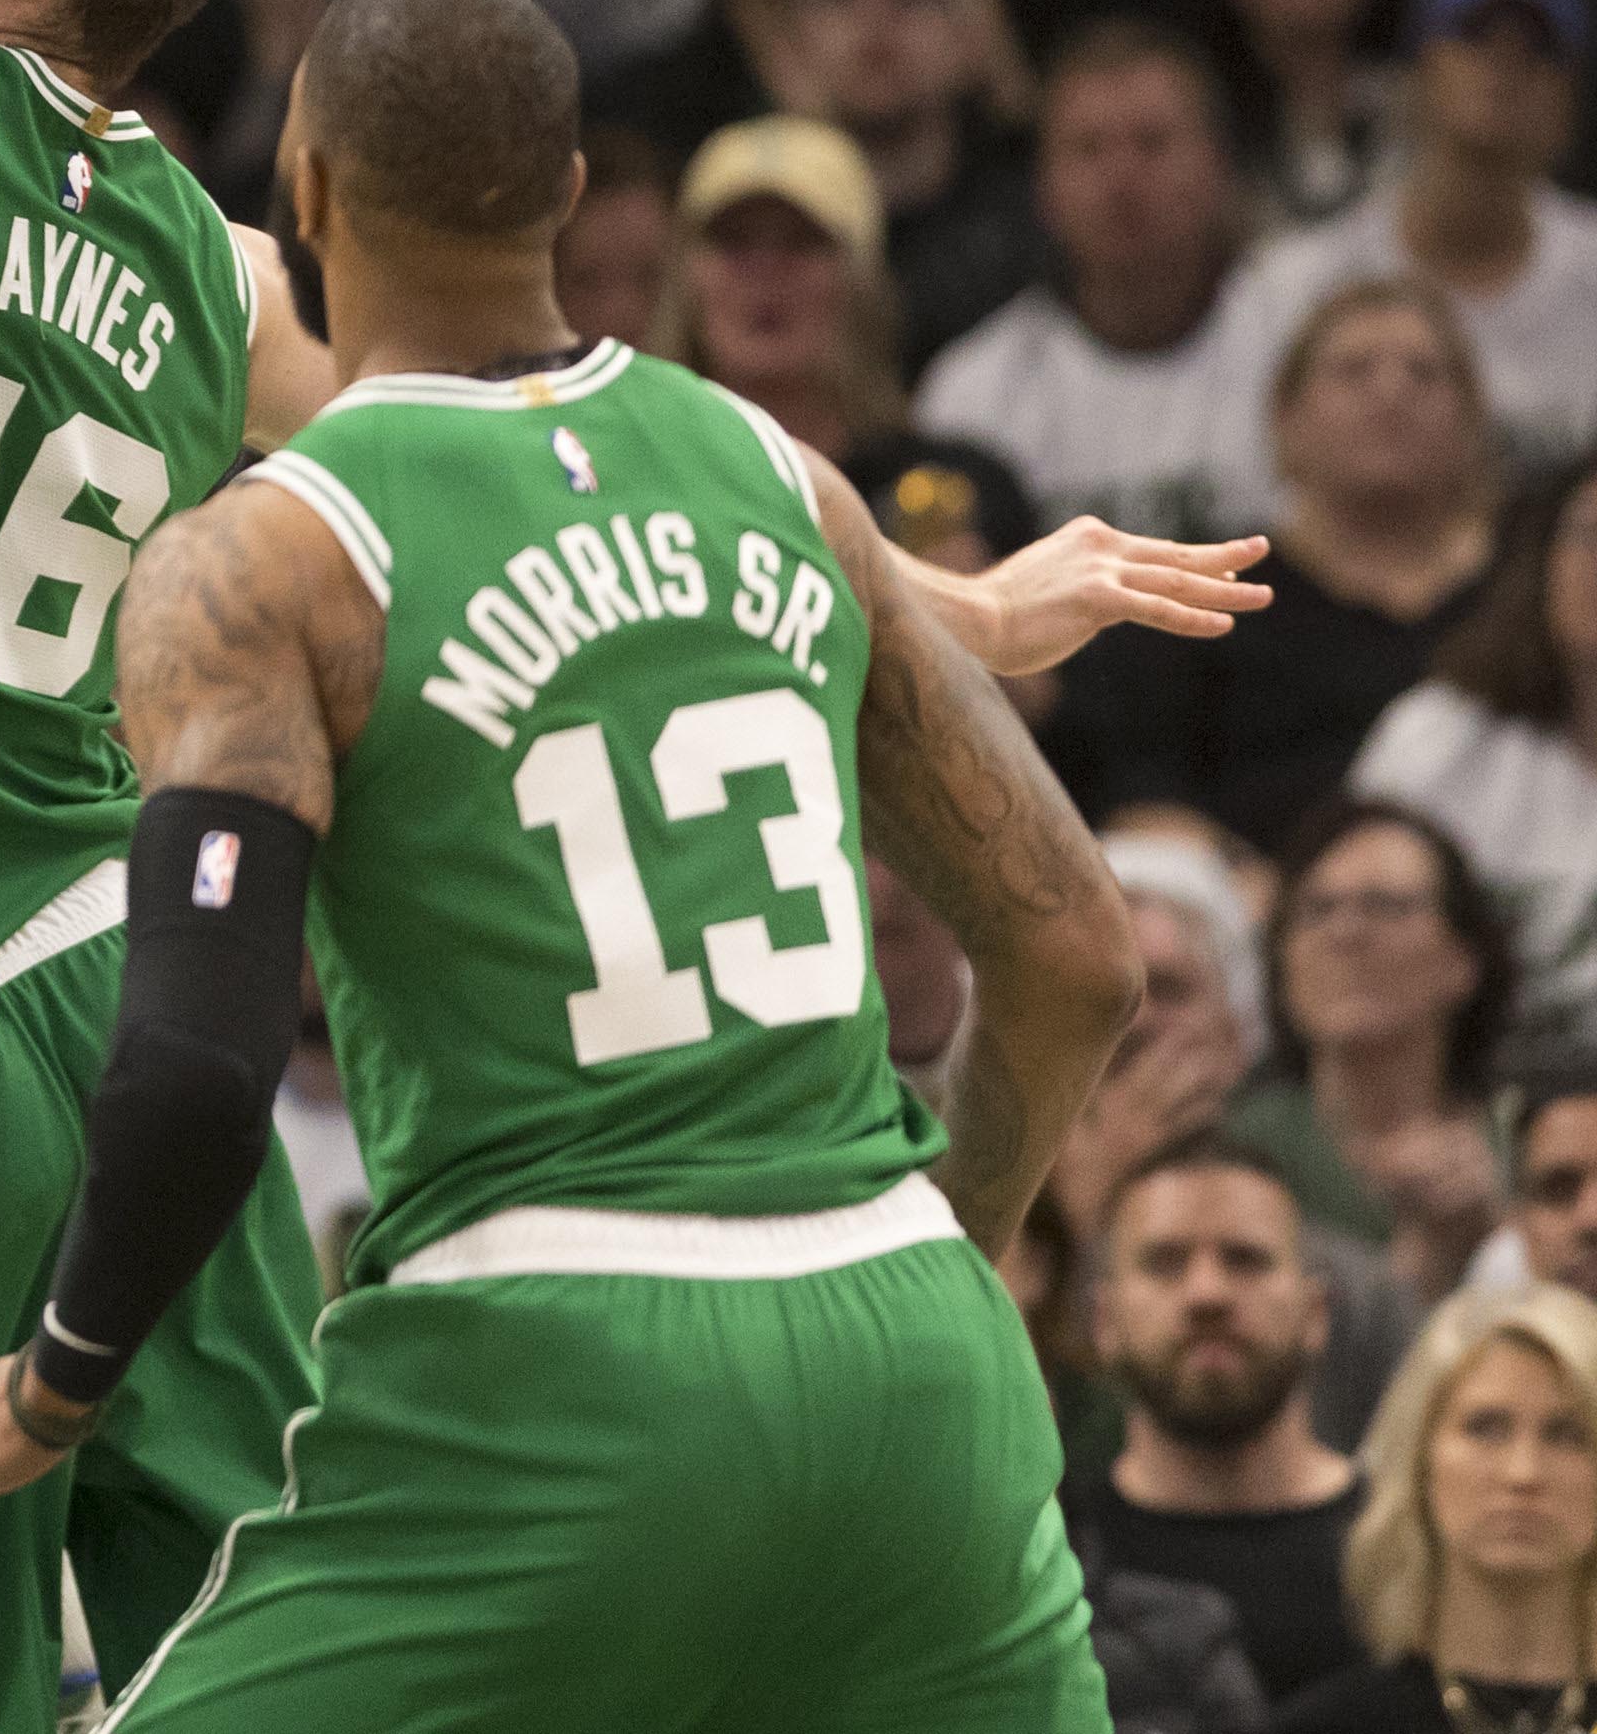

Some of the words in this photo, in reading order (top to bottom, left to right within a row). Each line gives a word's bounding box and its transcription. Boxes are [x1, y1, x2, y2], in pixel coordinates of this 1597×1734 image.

[422, 510, 710, 748] MORRIS
[731, 530, 835, 687] SR.
[513, 688, 867, 1066] 13
